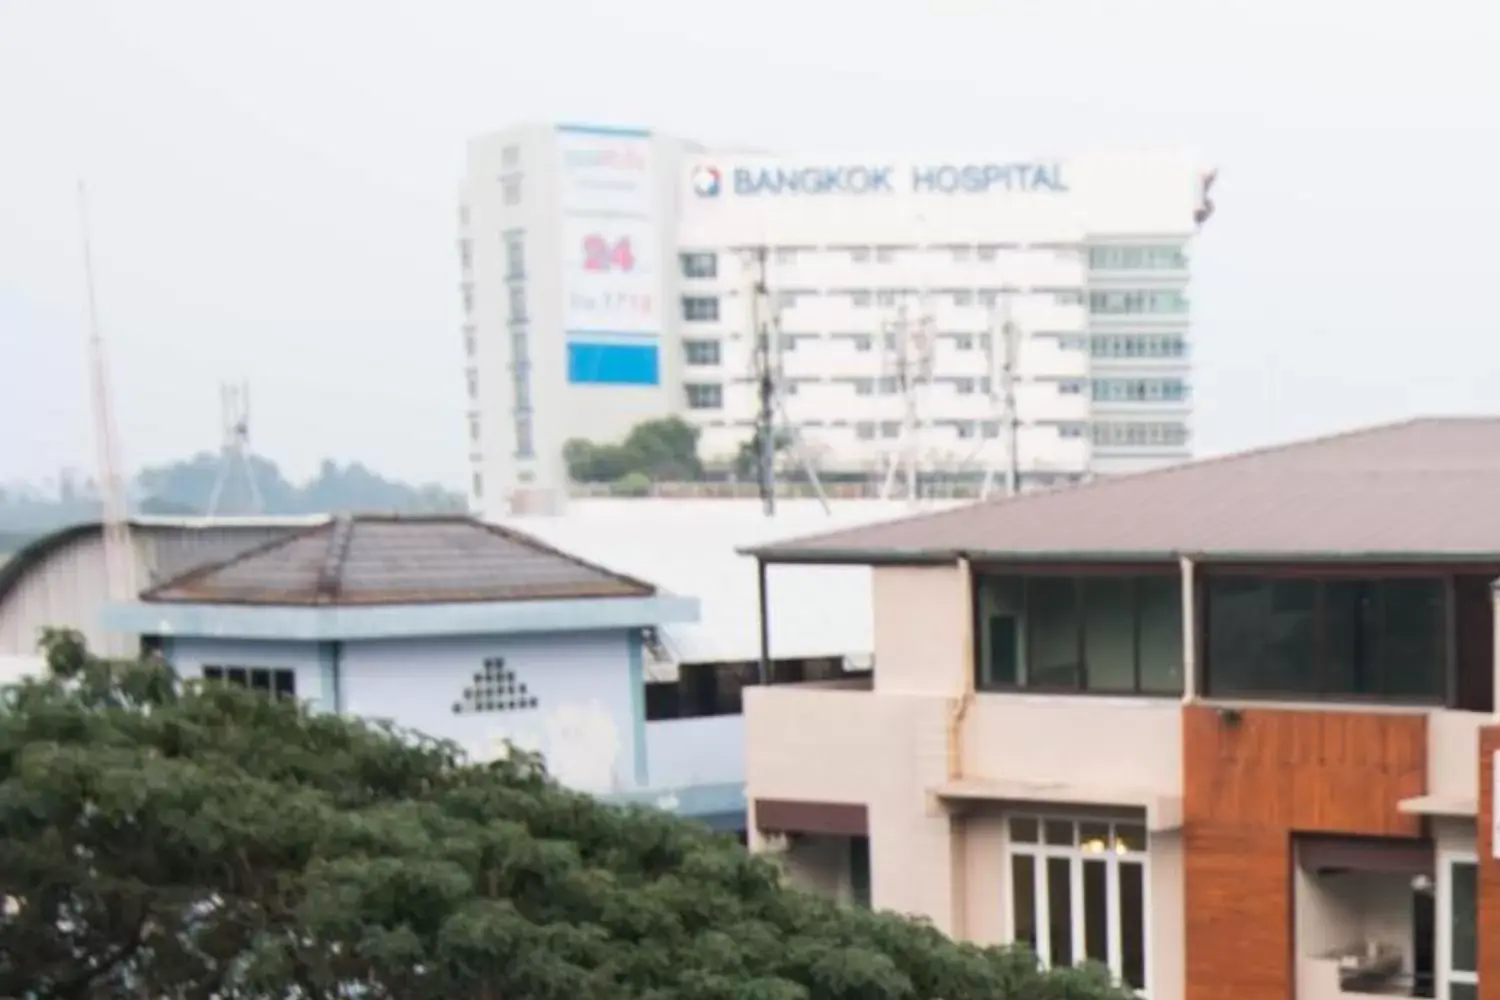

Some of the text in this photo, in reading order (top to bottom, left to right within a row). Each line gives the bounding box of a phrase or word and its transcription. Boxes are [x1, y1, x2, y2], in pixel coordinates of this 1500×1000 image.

[733, 163, 1069, 196] BANGKOK HOSPITAL
[581, 233, 635, 272] 24
